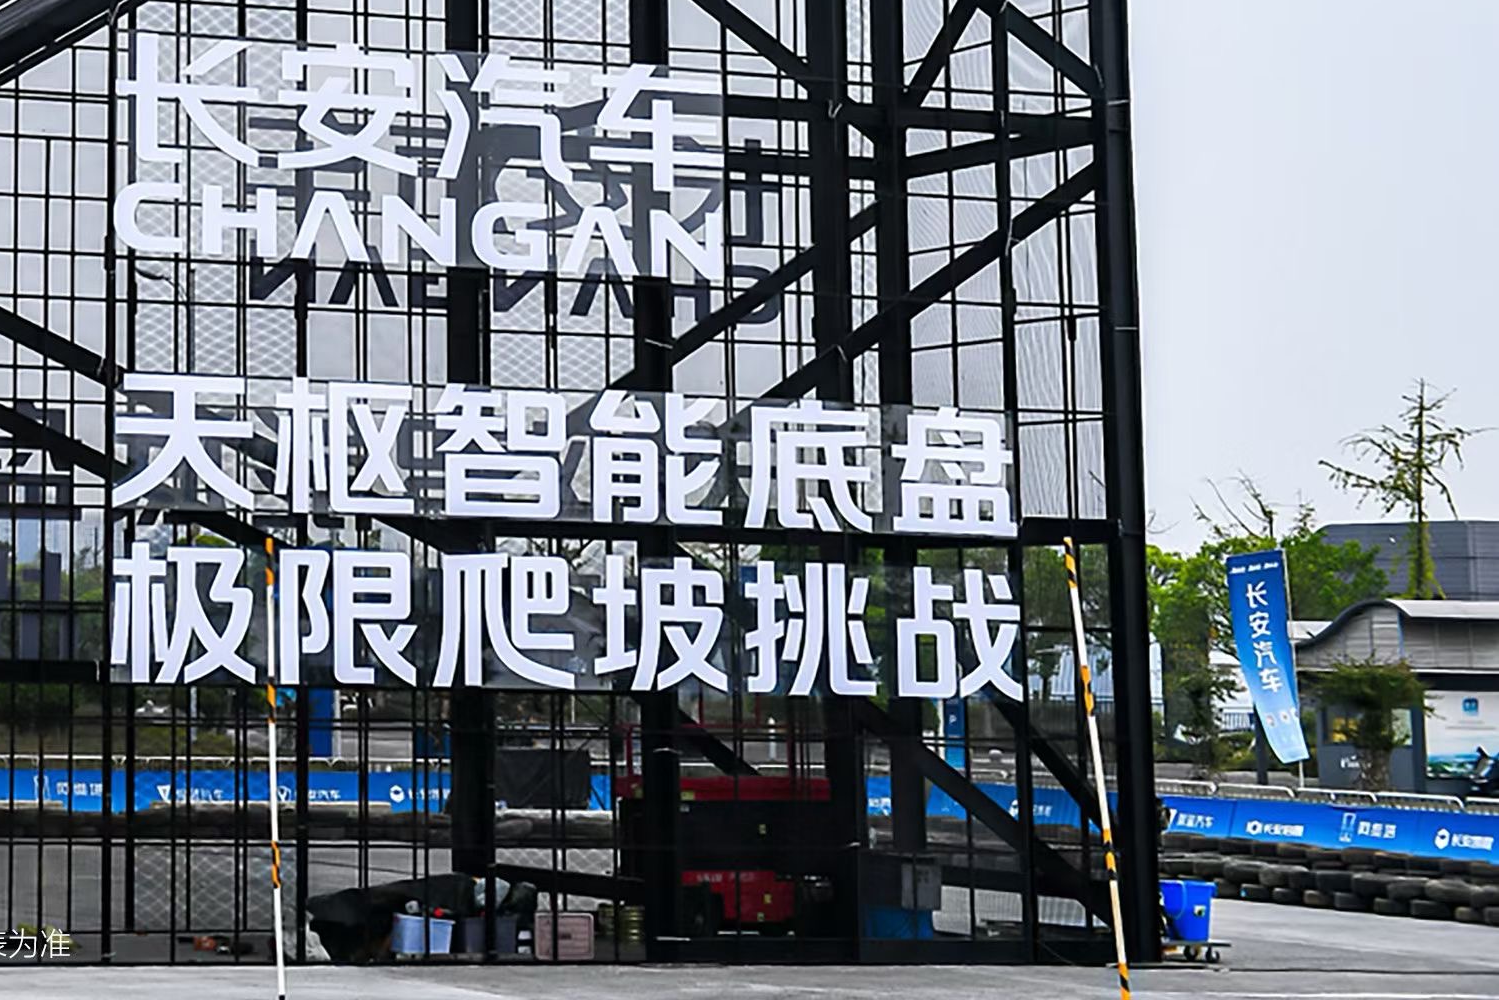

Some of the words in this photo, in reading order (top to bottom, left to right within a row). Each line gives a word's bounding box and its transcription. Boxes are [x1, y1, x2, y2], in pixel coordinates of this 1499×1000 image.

[114, 33, 723, 191] 长安汽车
[113, 182, 724, 280] CHANGAN
[112, 373, 1018, 537] 天枢智能底盘
[110, 542, 1023, 702] 极限爬坡挑战
[1245, 581, 1284, 693] 长安汽车
